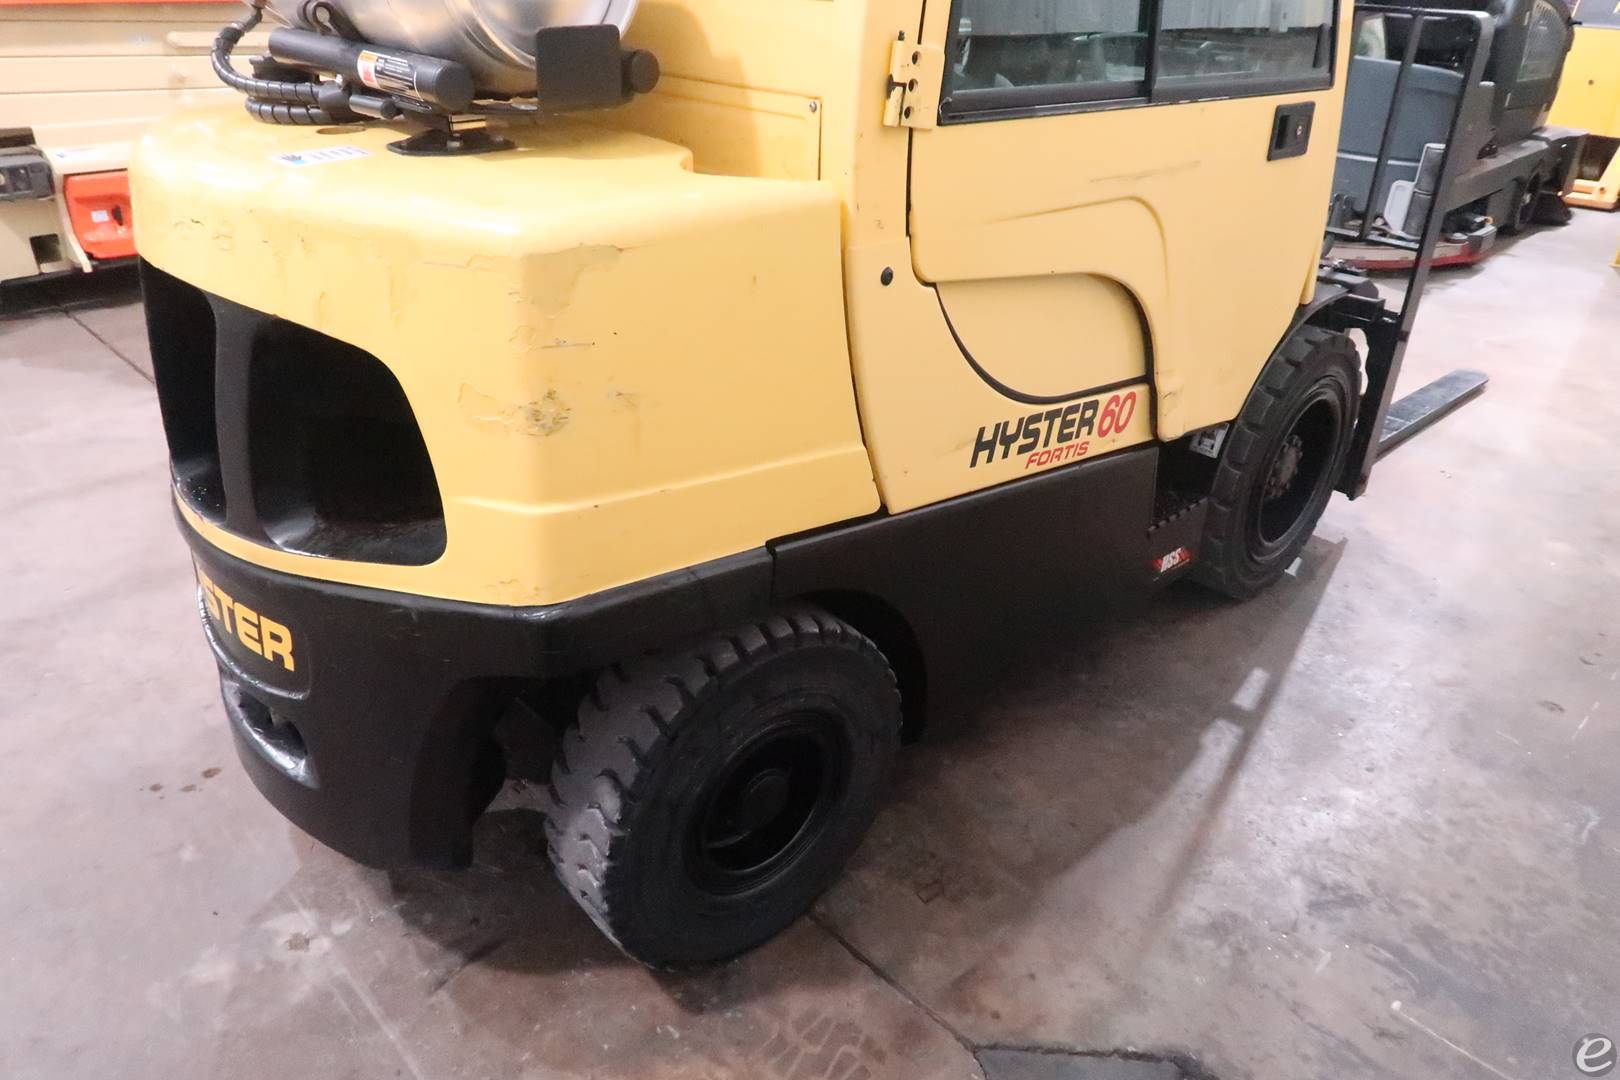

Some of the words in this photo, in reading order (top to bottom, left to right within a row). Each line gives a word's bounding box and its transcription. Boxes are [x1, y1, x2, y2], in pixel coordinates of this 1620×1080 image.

[969, 399, 1100, 468] HYSTER
[1097, 391, 1137, 438] 60
[1025, 441, 1090, 470] FORTIS
[196, 562, 295, 672] STER
